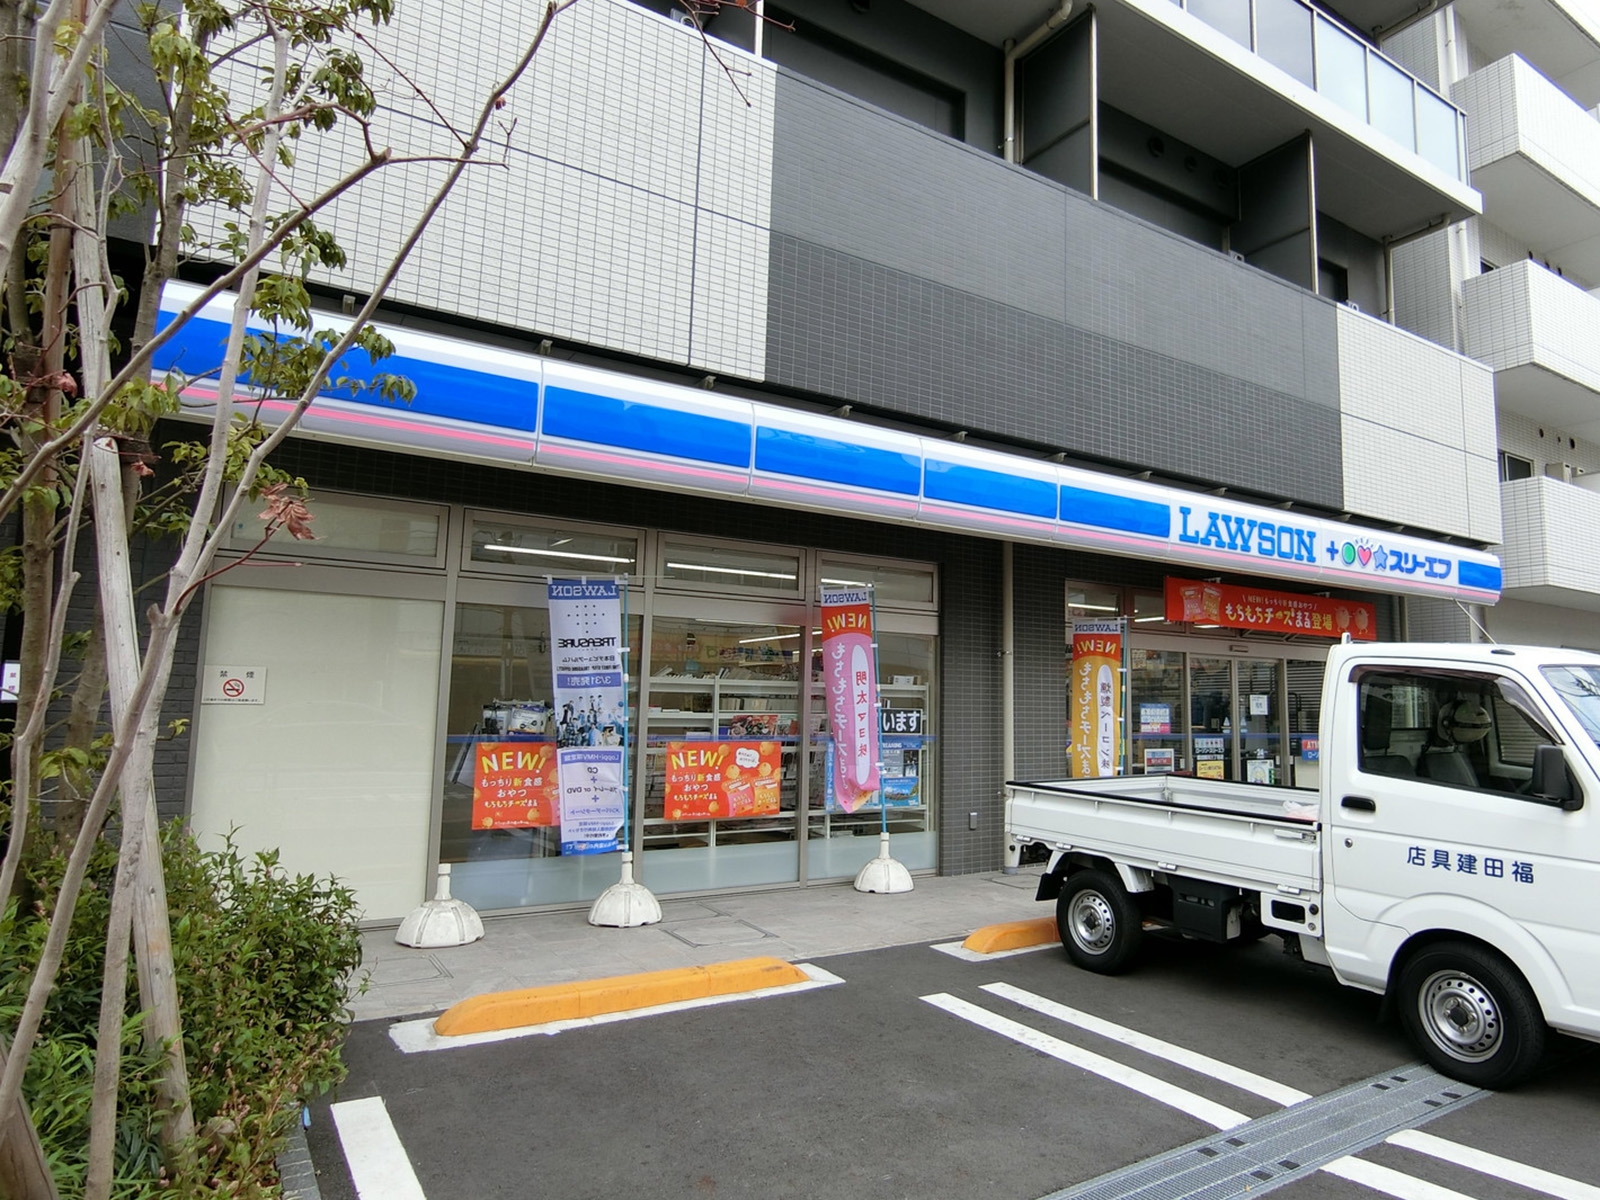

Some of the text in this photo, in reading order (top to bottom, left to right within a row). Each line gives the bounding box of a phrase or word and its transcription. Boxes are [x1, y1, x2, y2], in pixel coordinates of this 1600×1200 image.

[1179, 506, 1316, 563] LAWSON
[1389, 550, 1452, 579] スリーエフ
[481, 751, 546, 774] NEW!
[671, 749, 724, 770] NEW!
[481, 776, 543, 788] もっちり新食感
[684, 783, 709, 792] おやつ
[497, 788, 527, 798] おやつ
